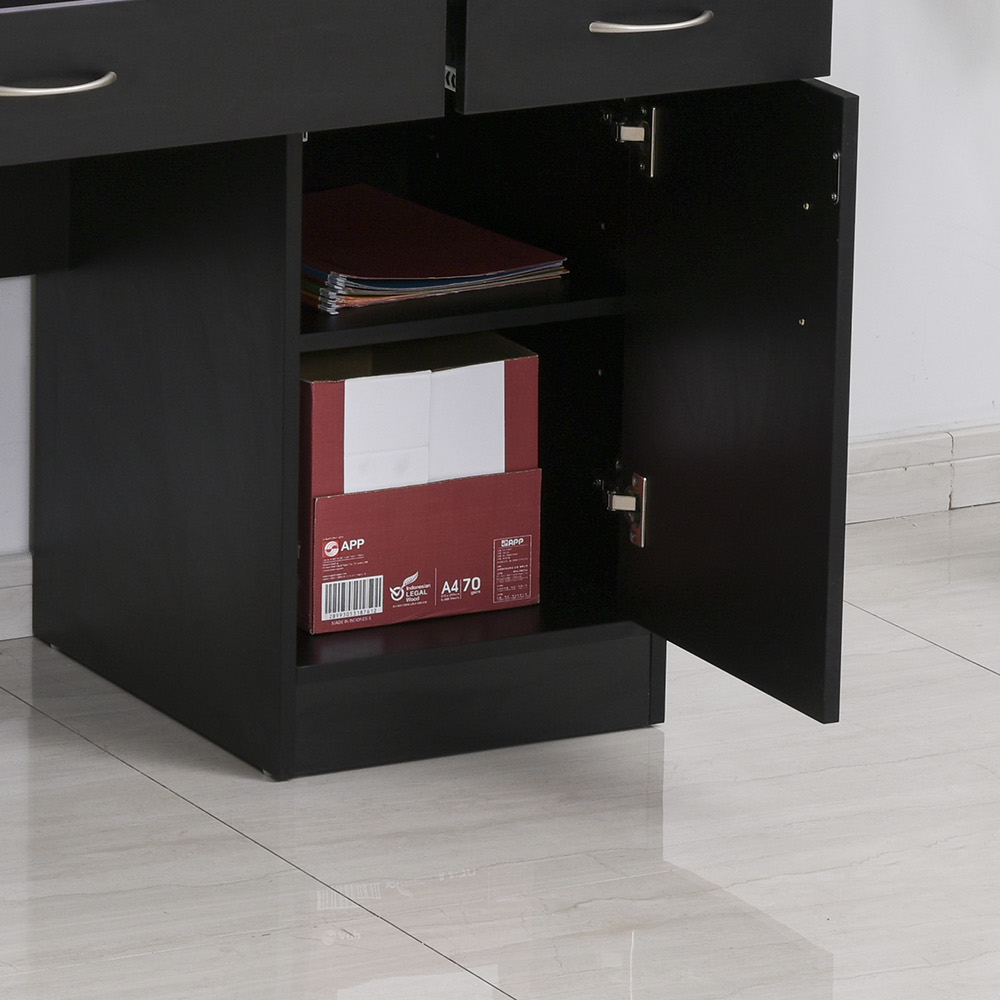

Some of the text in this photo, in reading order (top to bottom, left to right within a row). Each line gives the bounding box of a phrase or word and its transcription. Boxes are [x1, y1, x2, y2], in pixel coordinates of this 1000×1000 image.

[341, 538, 365, 552] APP
[405, 583, 432, 591] Indonesian
[441, 579, 459, 595] A4
[462, 576, 481, 592] 70
[405, 589, 428, 597] LEGAL
